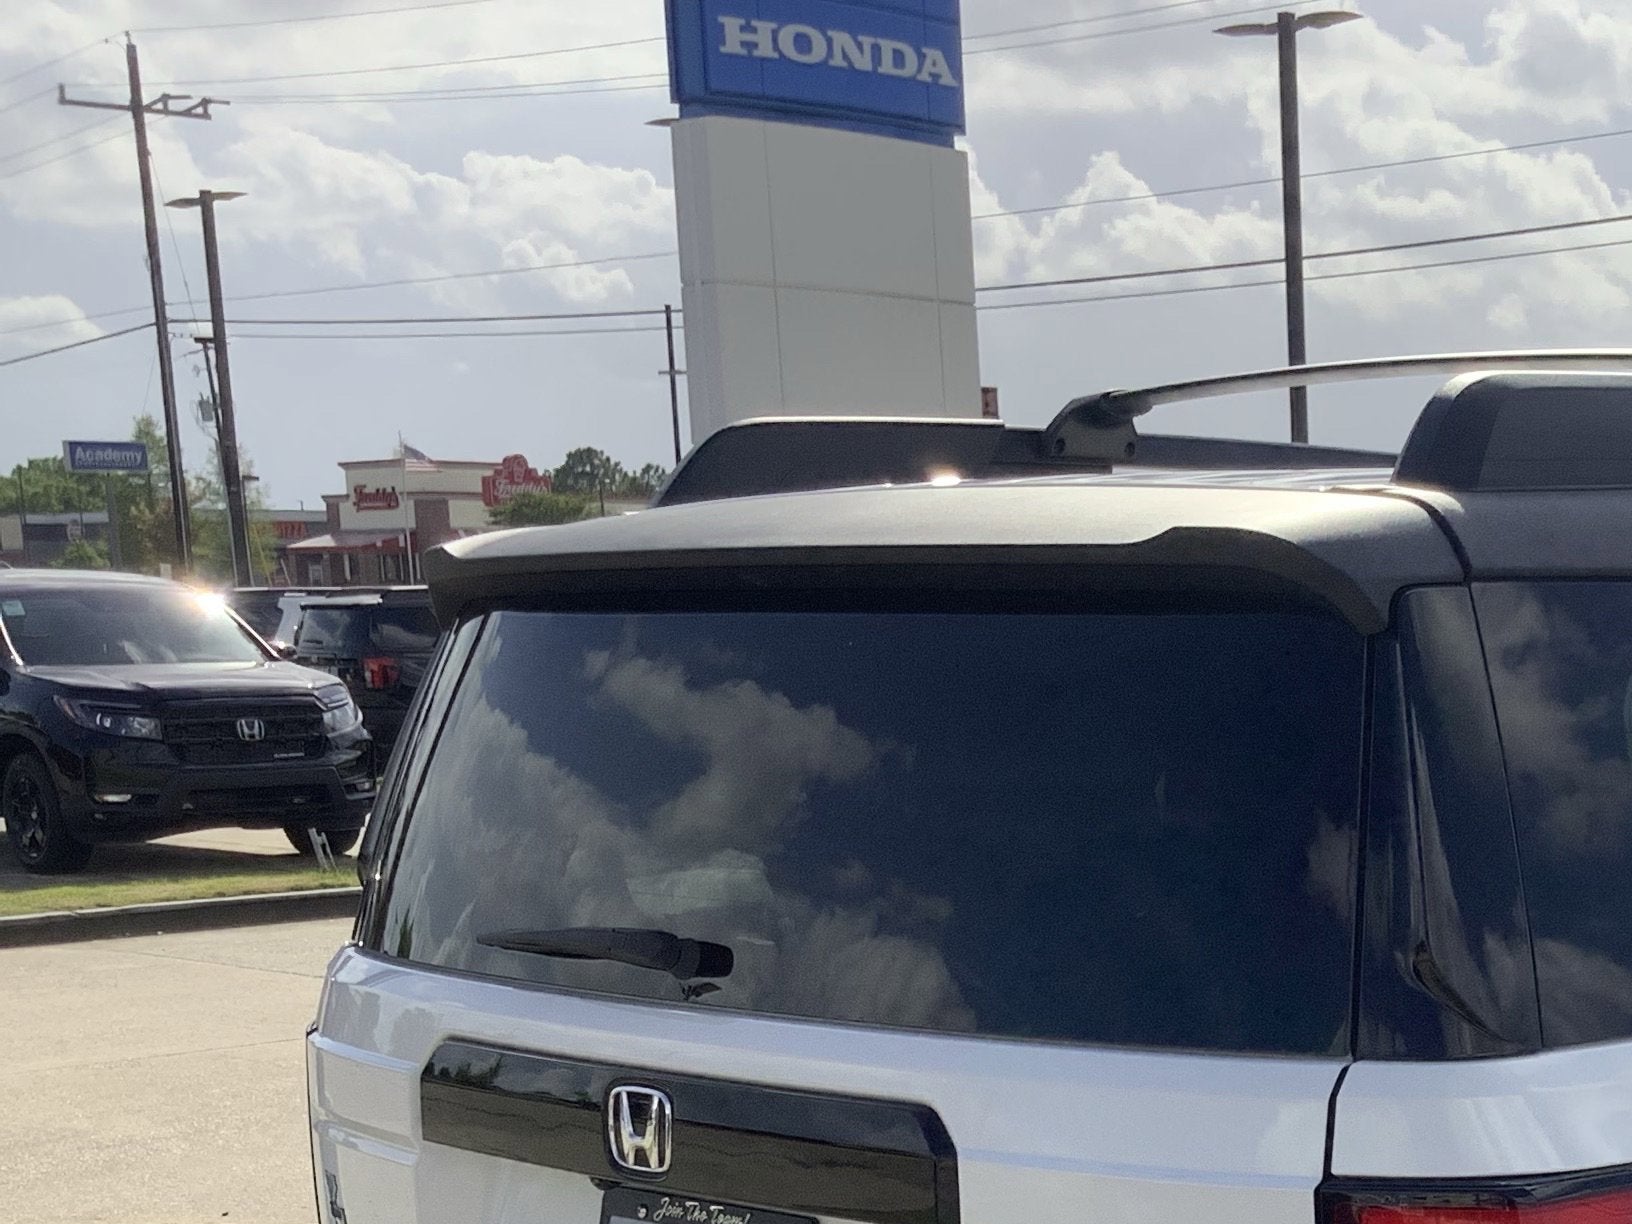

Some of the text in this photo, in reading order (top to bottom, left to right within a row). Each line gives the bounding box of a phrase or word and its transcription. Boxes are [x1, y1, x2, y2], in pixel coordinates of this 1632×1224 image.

[717, 15, 959, 88] HONDA
[75, 446, 142, 466] Academy
[653, 1197, 684, 1222] Join
[685, 1202, 708, 1222] The
